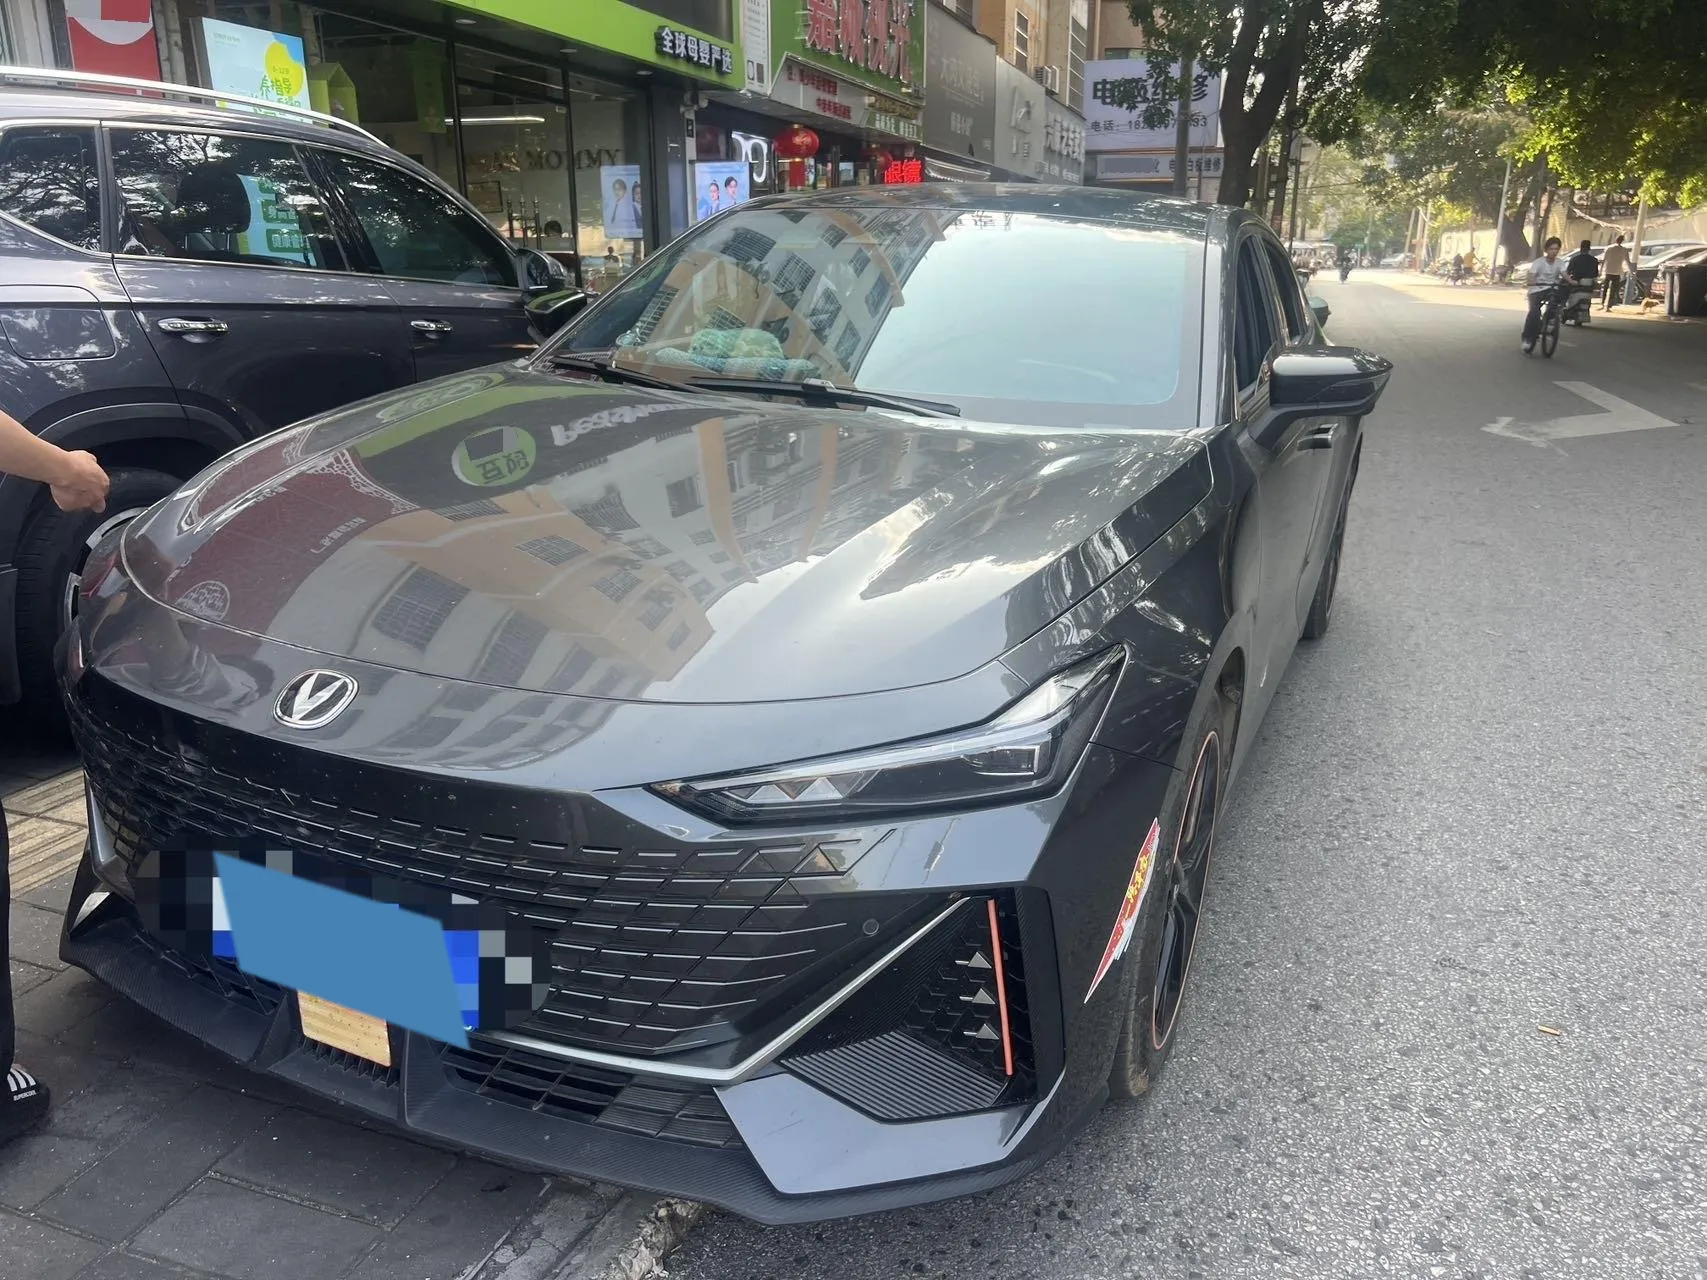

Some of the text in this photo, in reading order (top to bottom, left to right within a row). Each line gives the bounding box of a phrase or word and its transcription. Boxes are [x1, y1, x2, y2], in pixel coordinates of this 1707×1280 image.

[660, 26, 733, 74] 全球母婴严选
